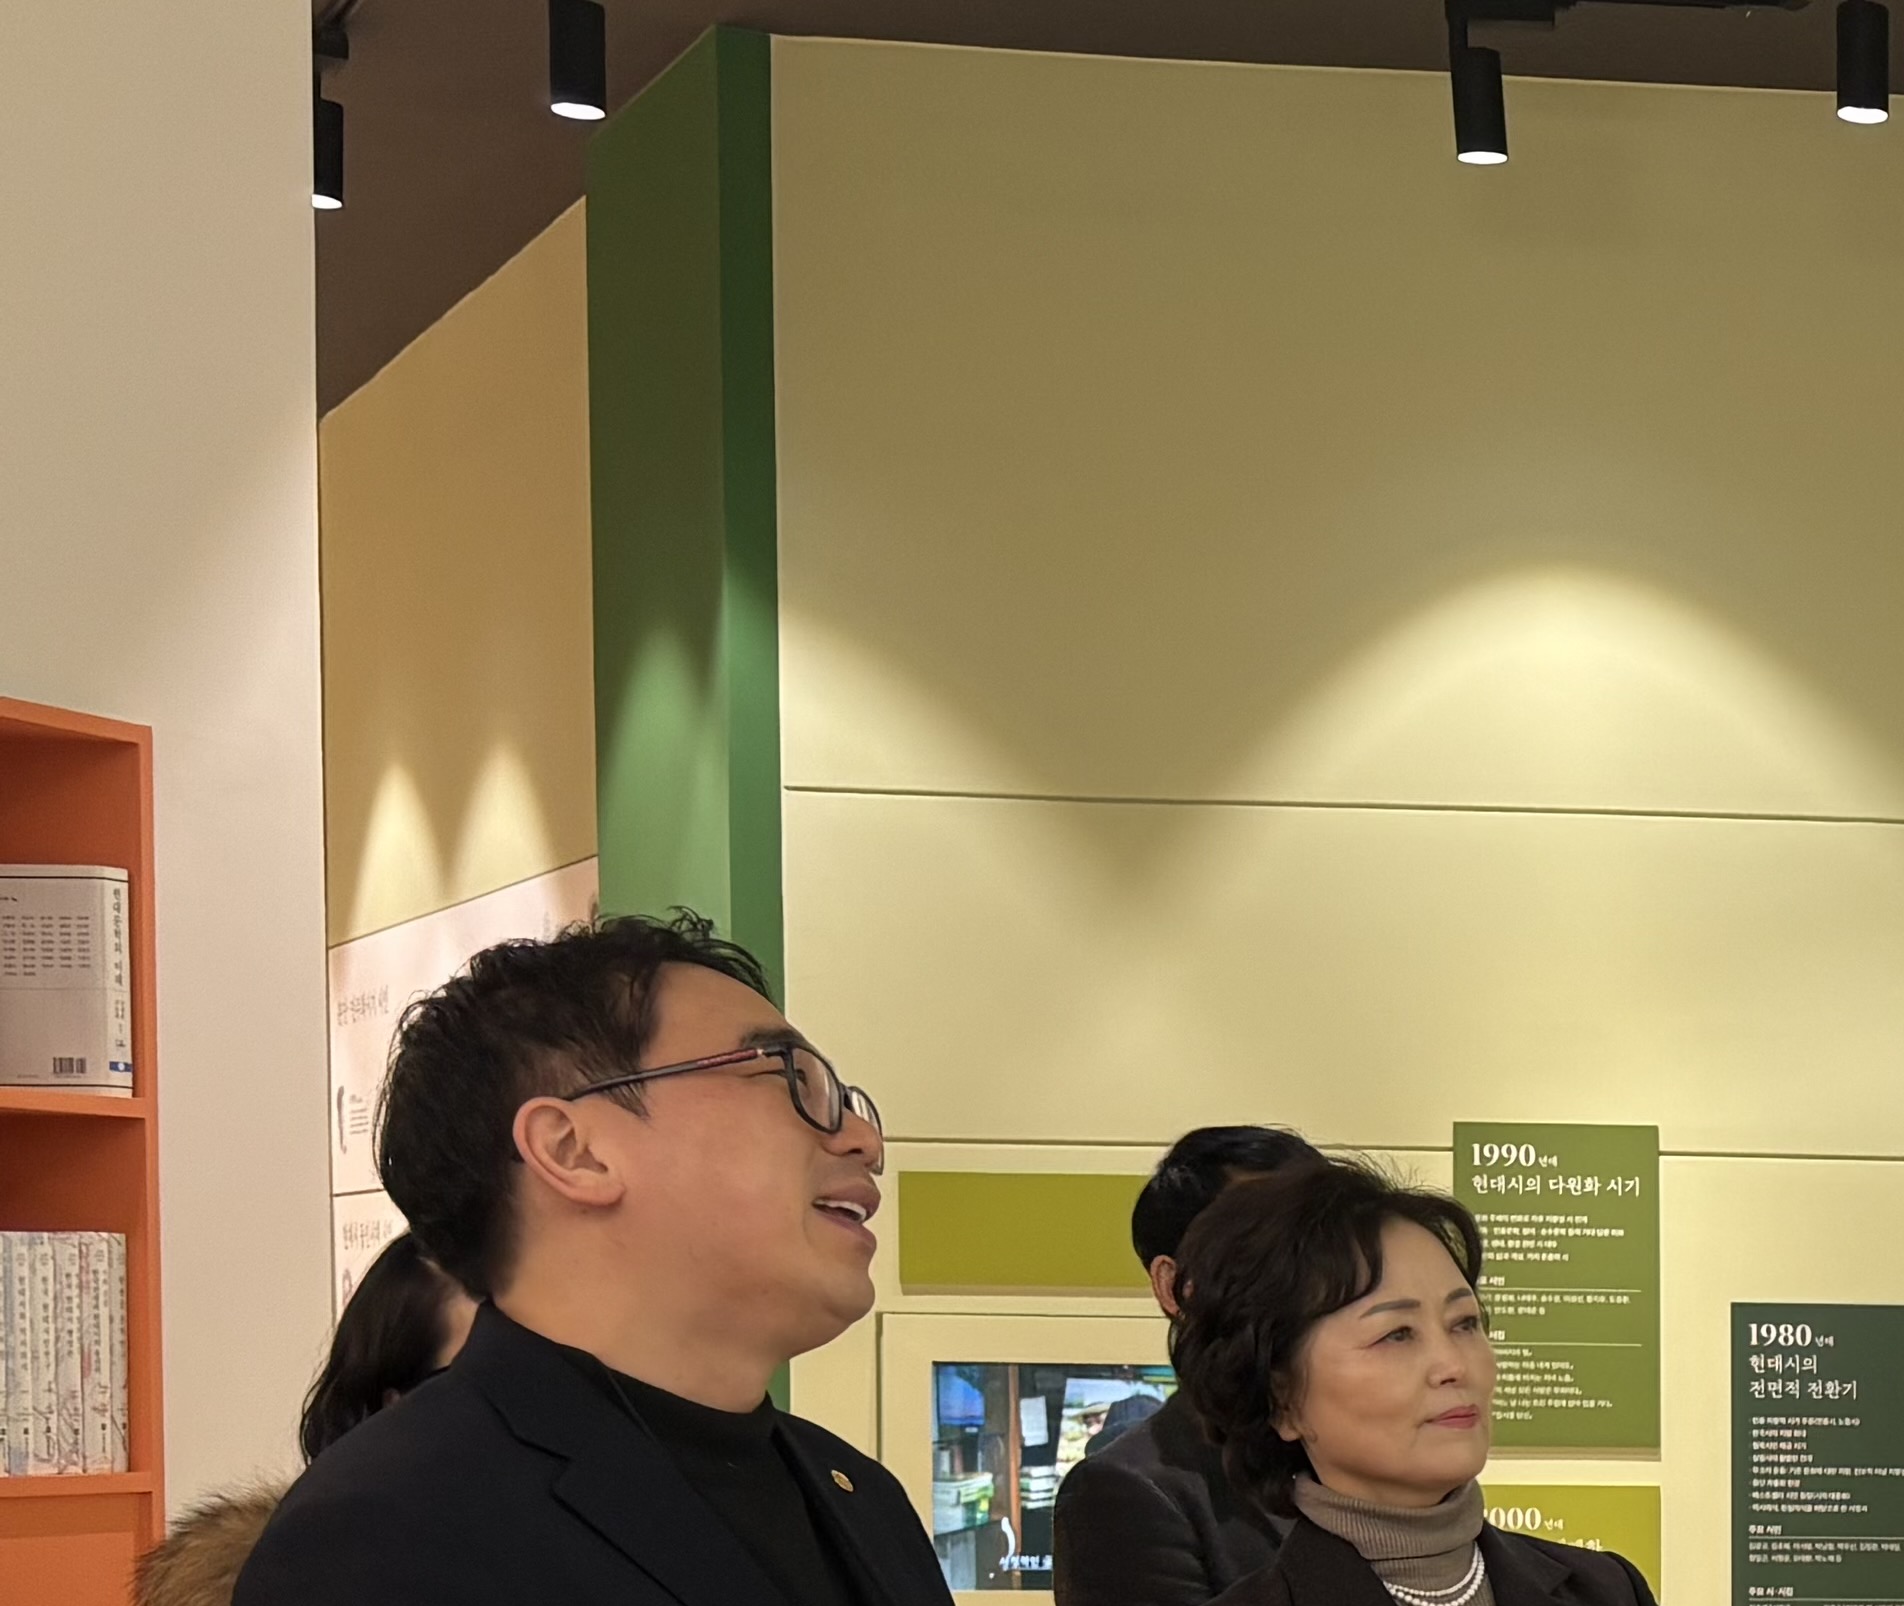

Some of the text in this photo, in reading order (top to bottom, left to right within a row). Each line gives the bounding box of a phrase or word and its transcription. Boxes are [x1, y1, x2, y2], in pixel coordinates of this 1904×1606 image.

[1472, 1174, 1640, 1197] 현대시의 다원화 시기
[1749, 1354, 1817, 1374] 현대시의
[1749, 1379, 1857, 1400] 전면적 전환기
